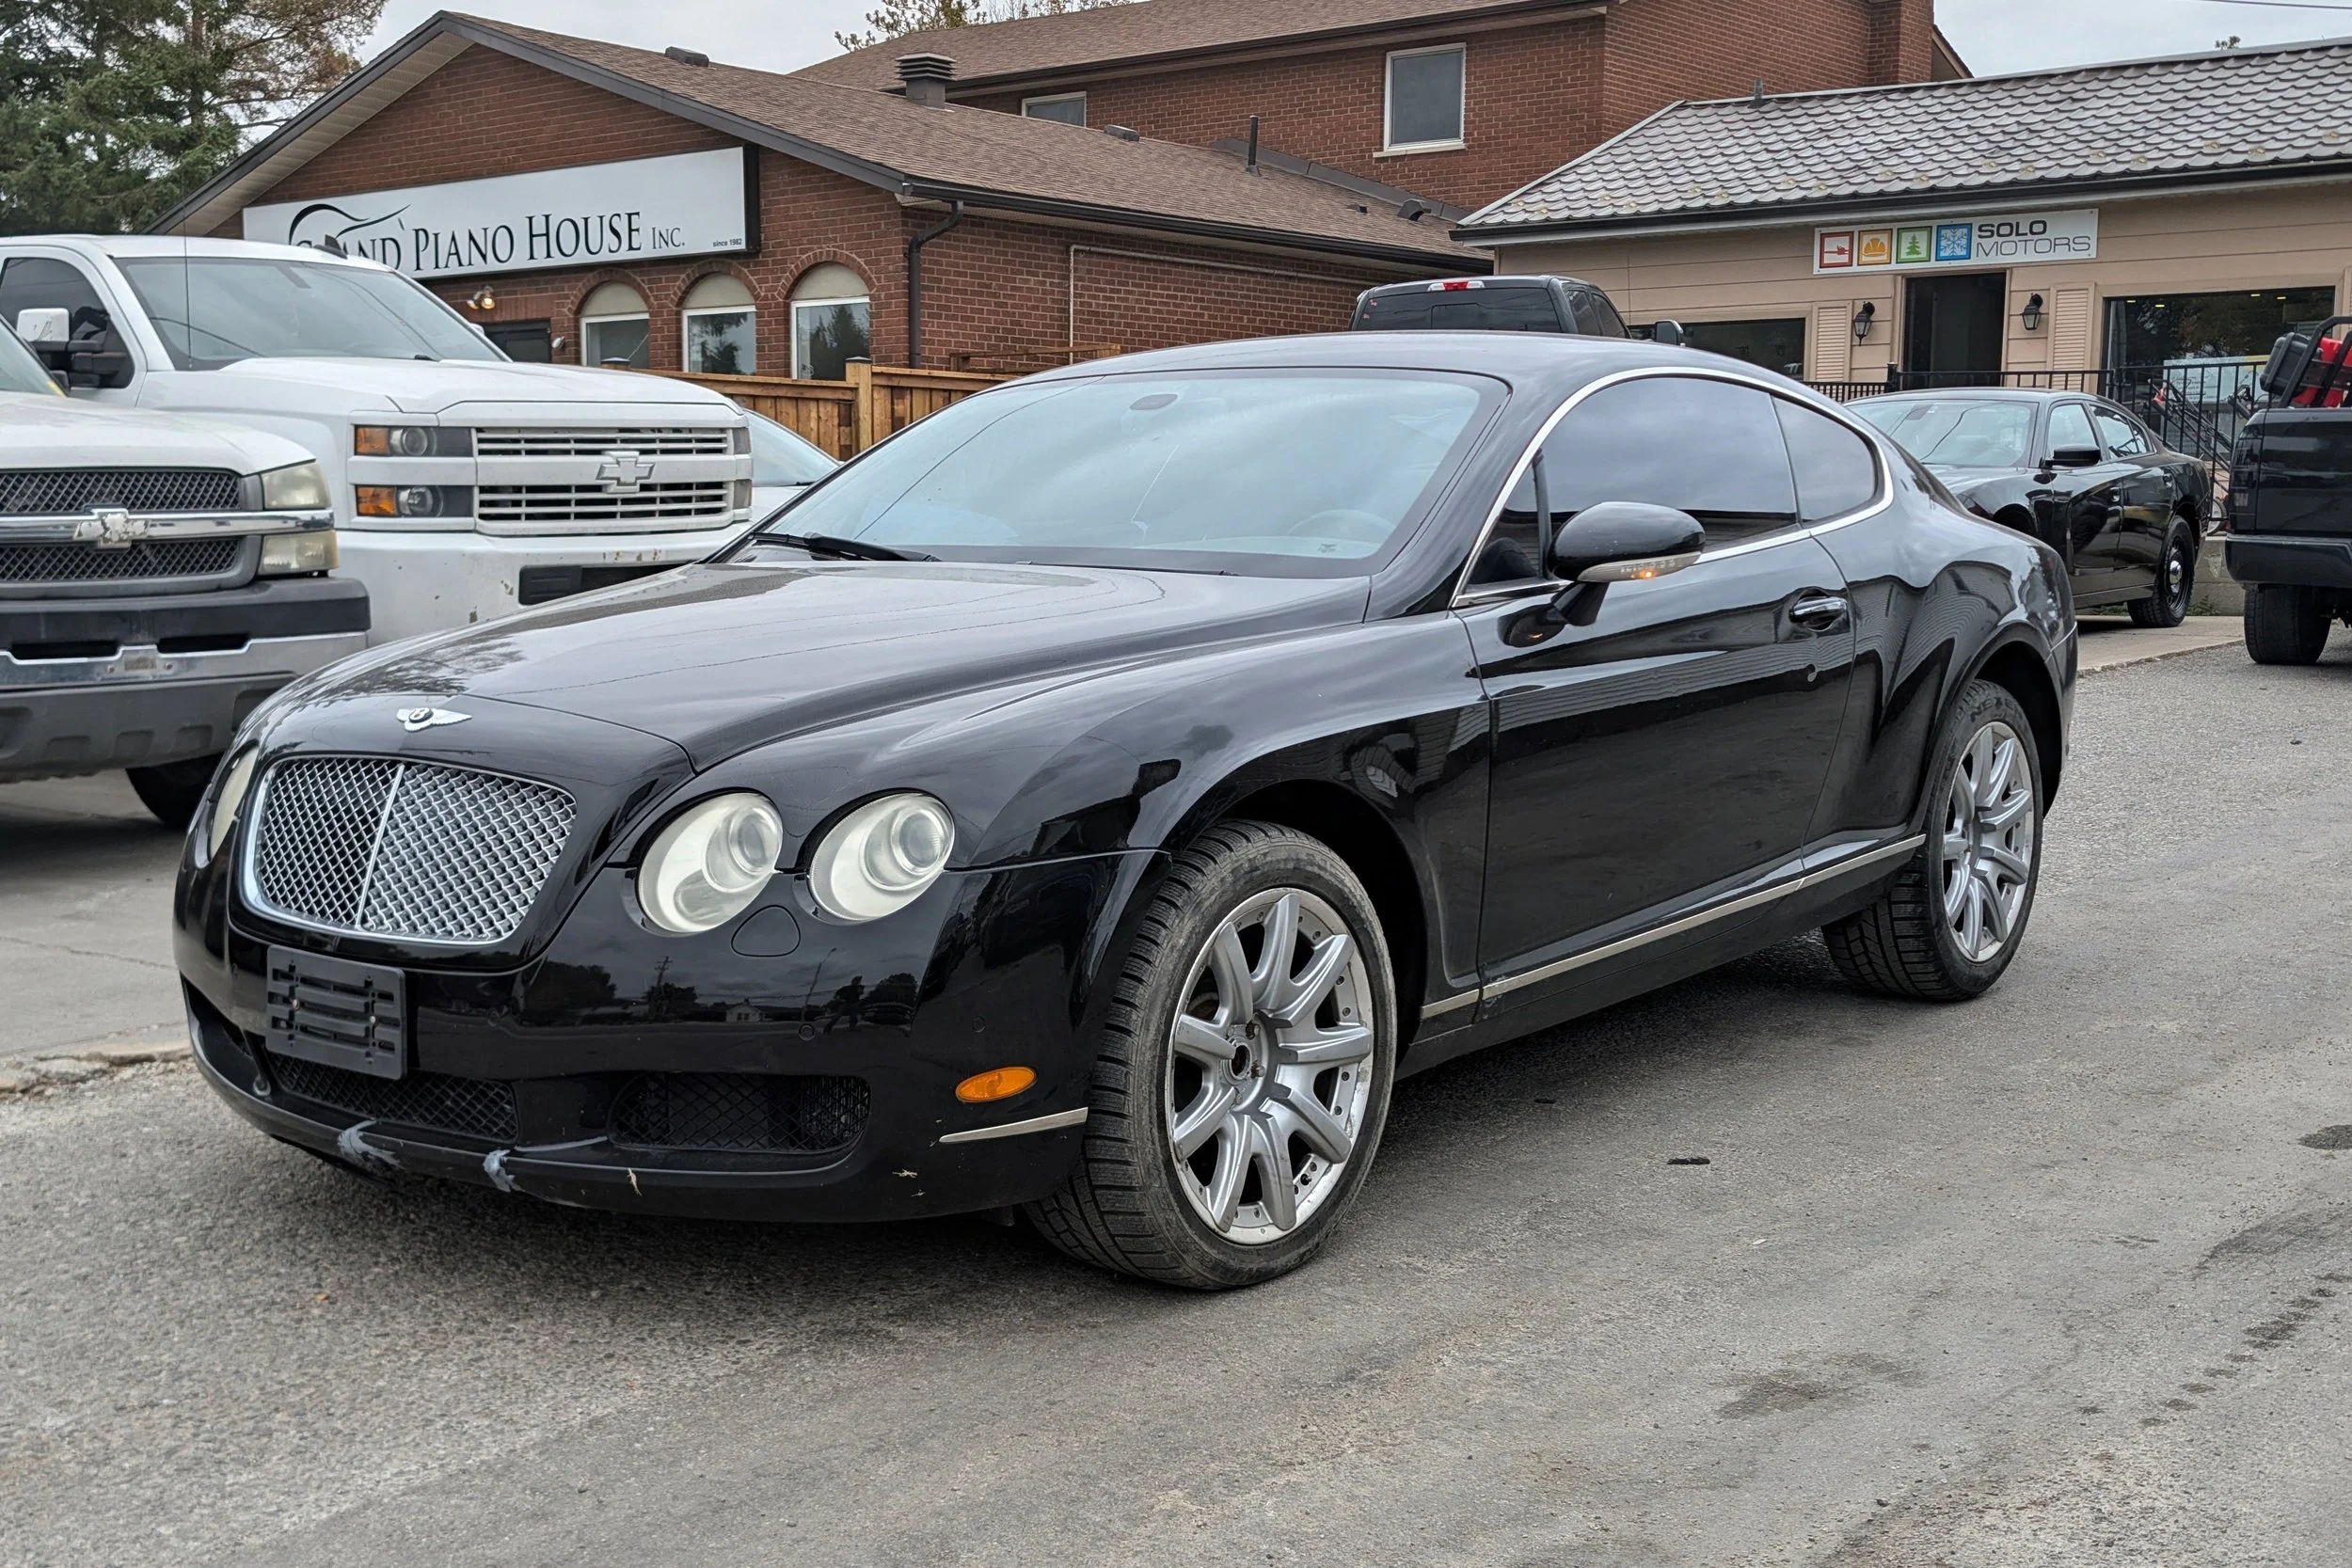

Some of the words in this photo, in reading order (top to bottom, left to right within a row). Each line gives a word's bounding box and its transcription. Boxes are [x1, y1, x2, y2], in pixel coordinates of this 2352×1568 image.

[1978, 220, 2047, 239] SOLO
[412, 225, 515, 271] PIANO
[525, 211, 642, 261] HOUSE
[652, 227, 685, 249] INC.
[1976, 235, 2091, 257] MOTORS
